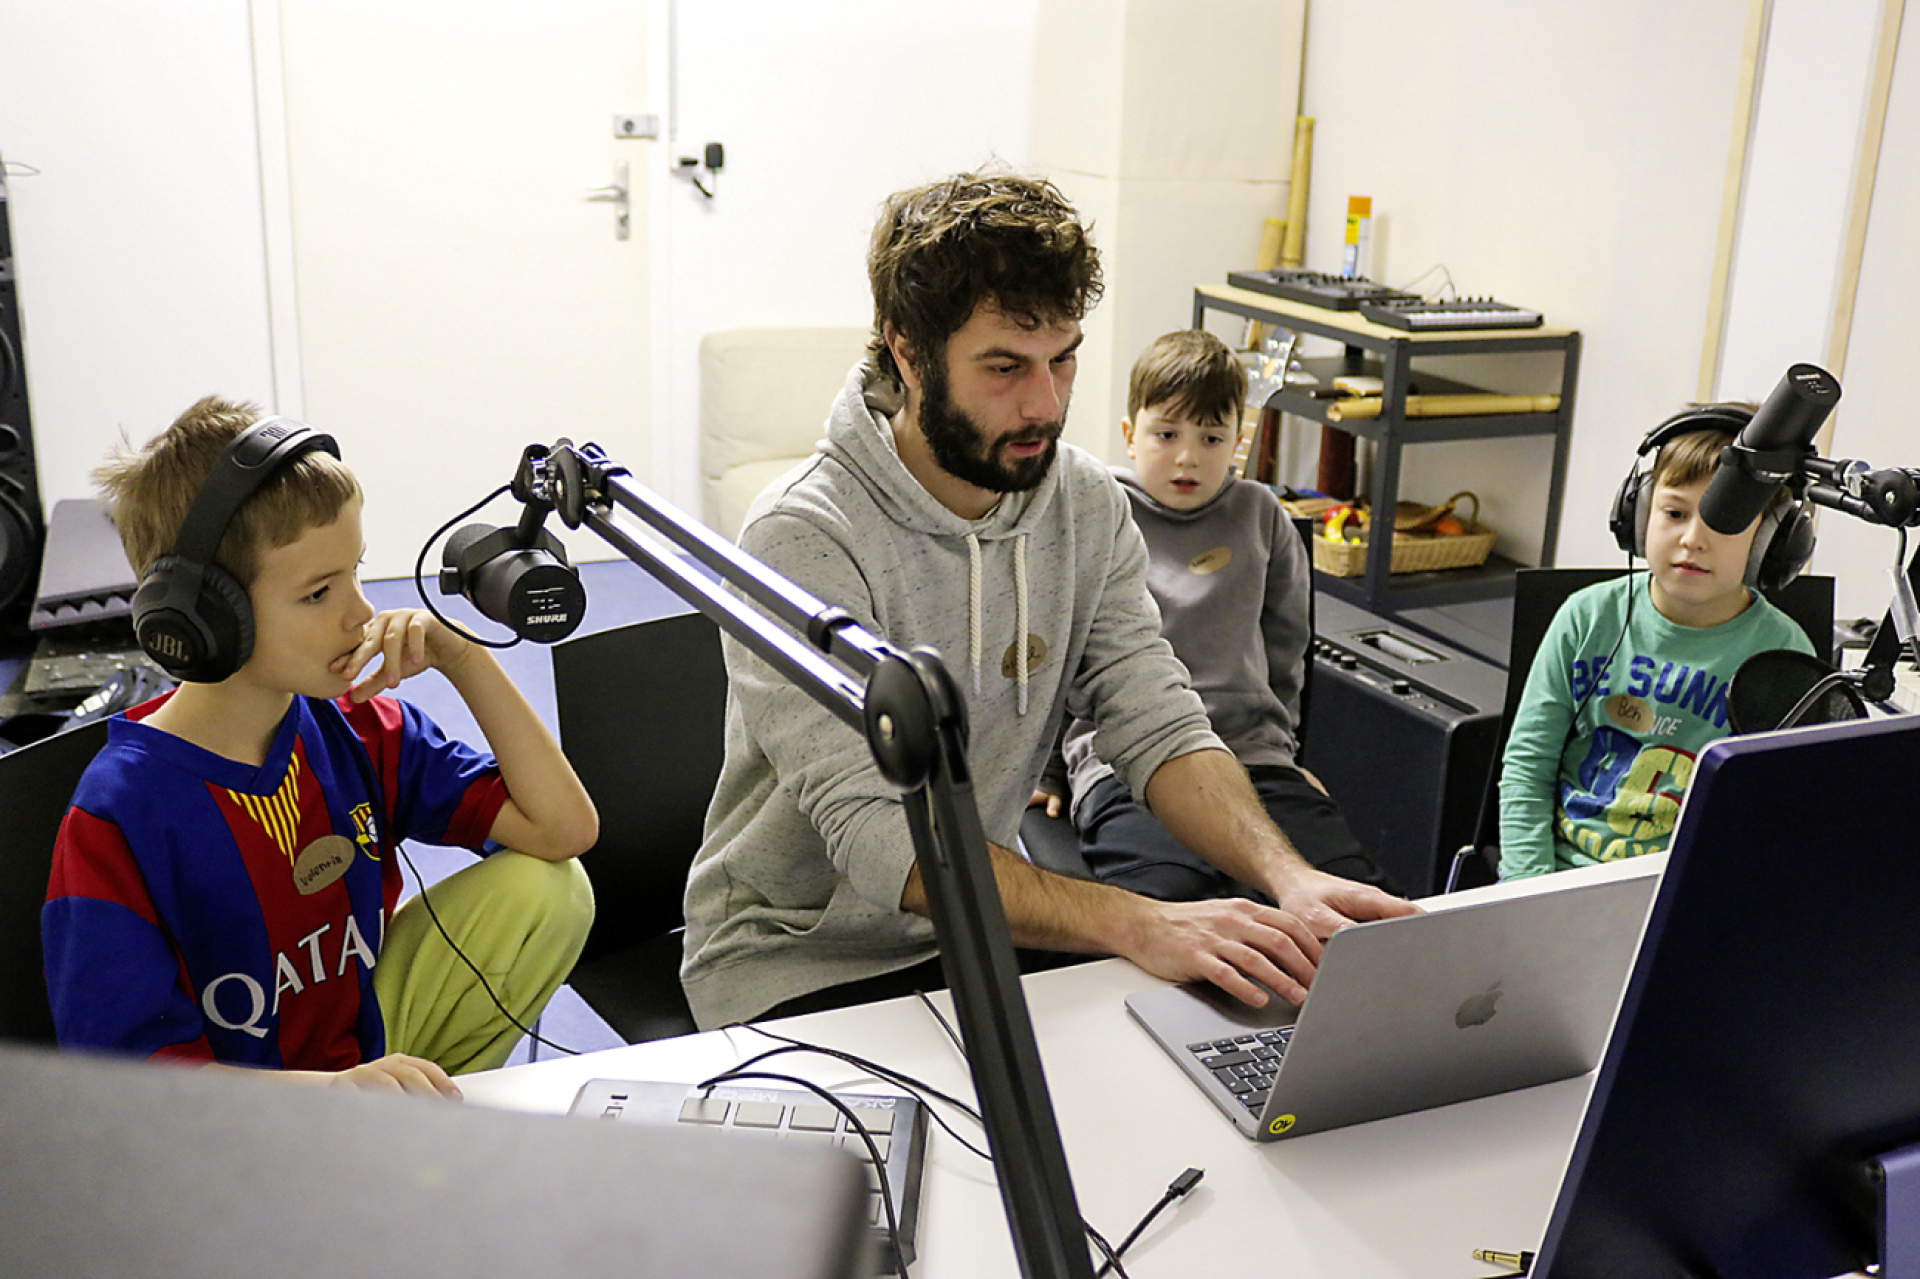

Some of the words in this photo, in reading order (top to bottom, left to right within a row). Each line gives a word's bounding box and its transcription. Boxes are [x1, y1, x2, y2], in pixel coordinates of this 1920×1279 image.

[149, 632, 189, 662] JBL
[1573, 656, 1613, 701] BE
[1628, 656, 1730, 730] SUNN
[1617, 697, 1641, 721] Ben
